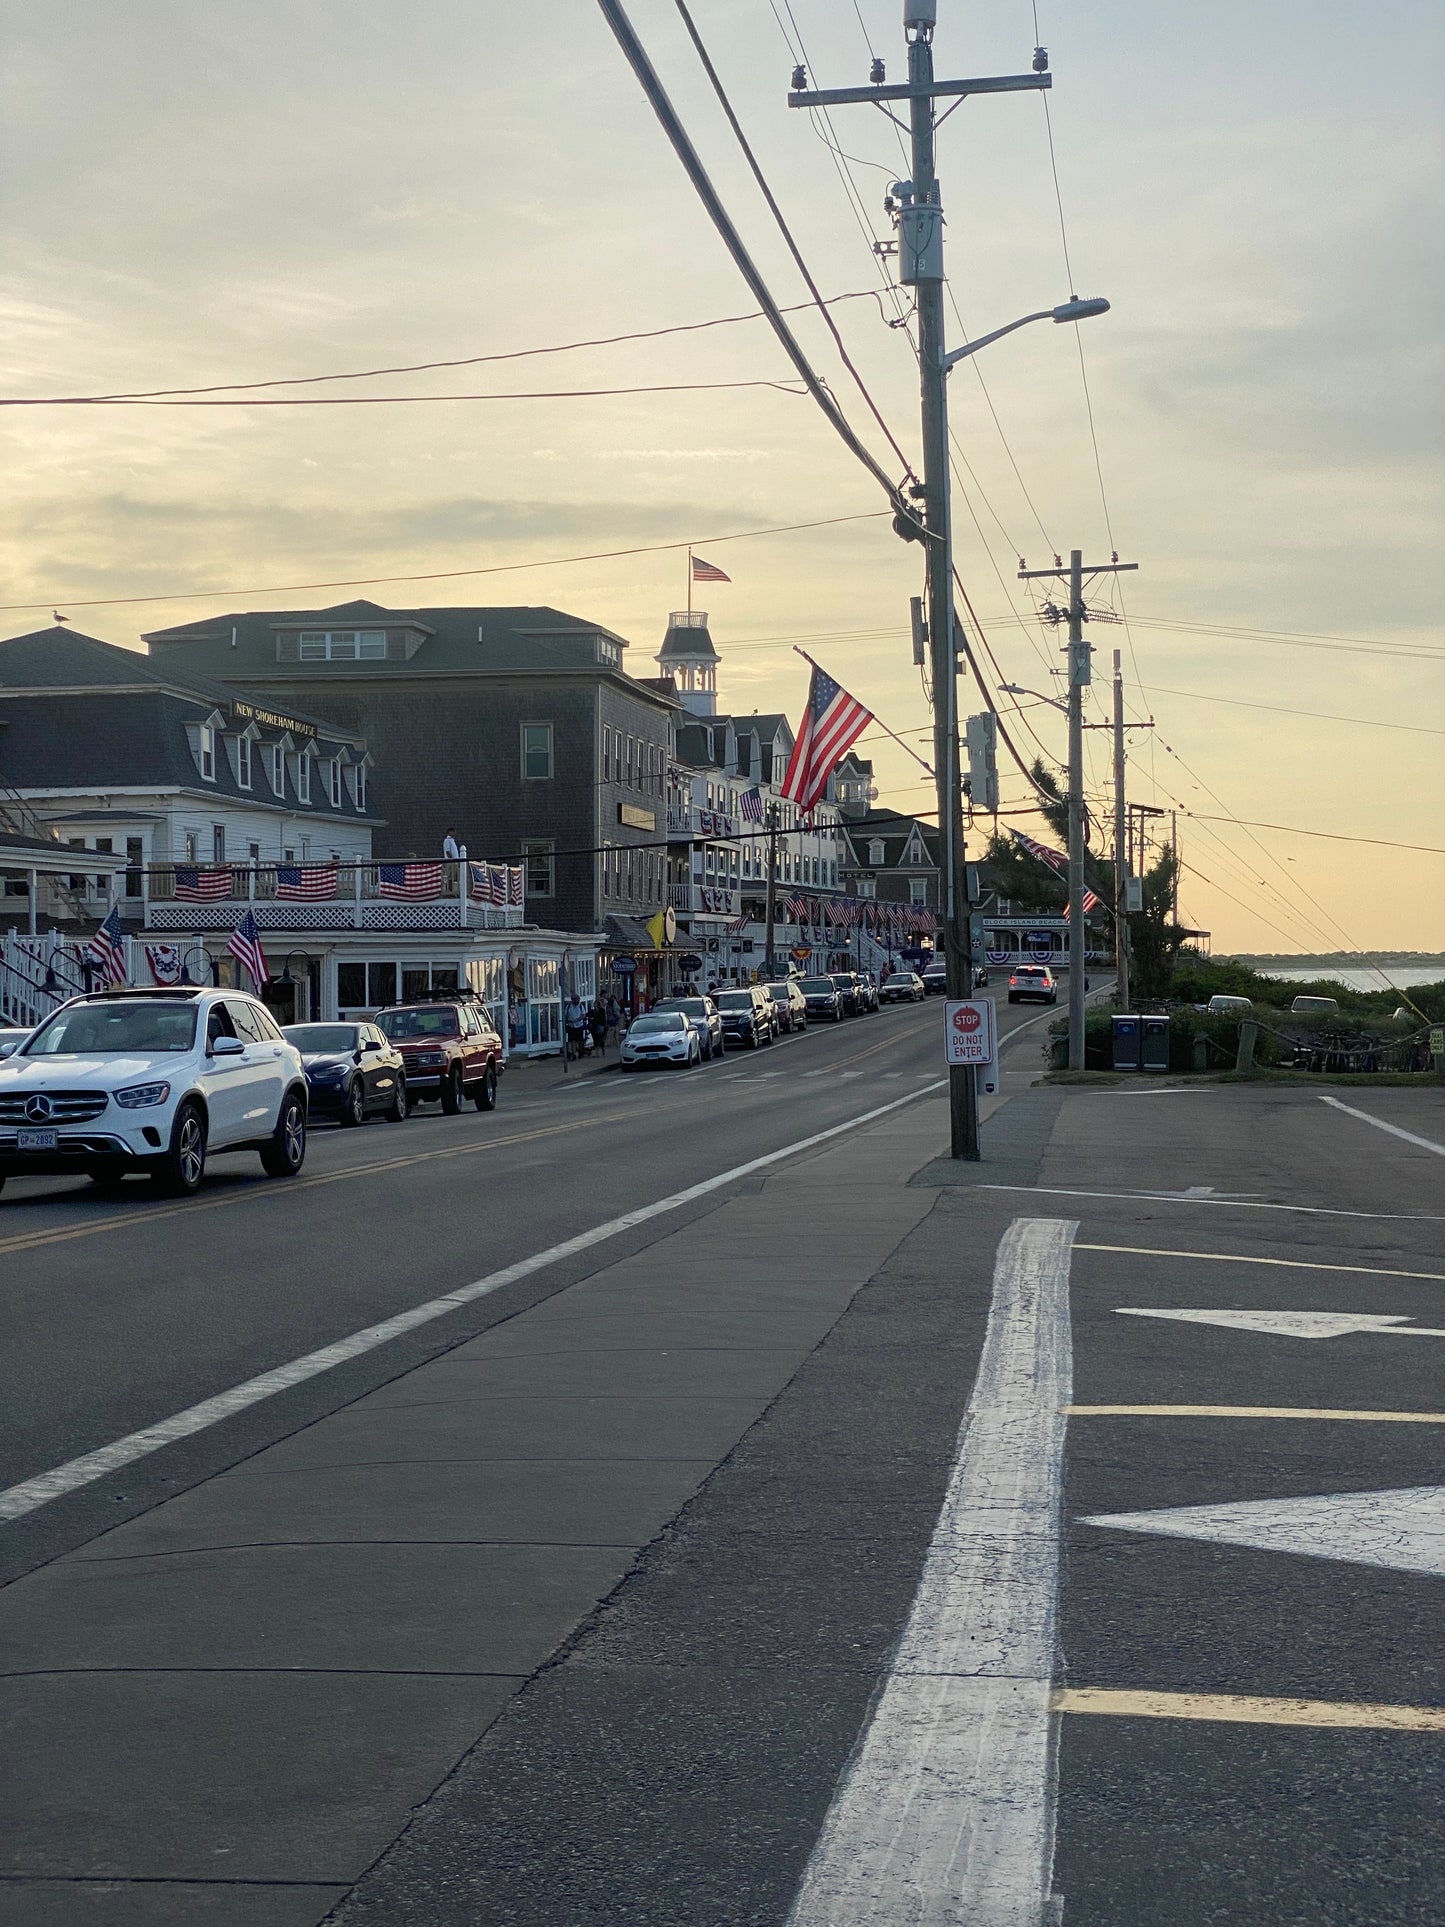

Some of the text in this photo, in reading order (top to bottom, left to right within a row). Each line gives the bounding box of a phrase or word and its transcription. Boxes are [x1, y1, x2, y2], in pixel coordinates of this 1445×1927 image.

[236, 702, 253, 718] NEW
[255, 709, 294, 730] SHOREHAM
[955, 1015, 978, 1025] STOP
[952, 1034, 983, 1045] DO NOT
[954, 1046, 982, 1057] ENTER
